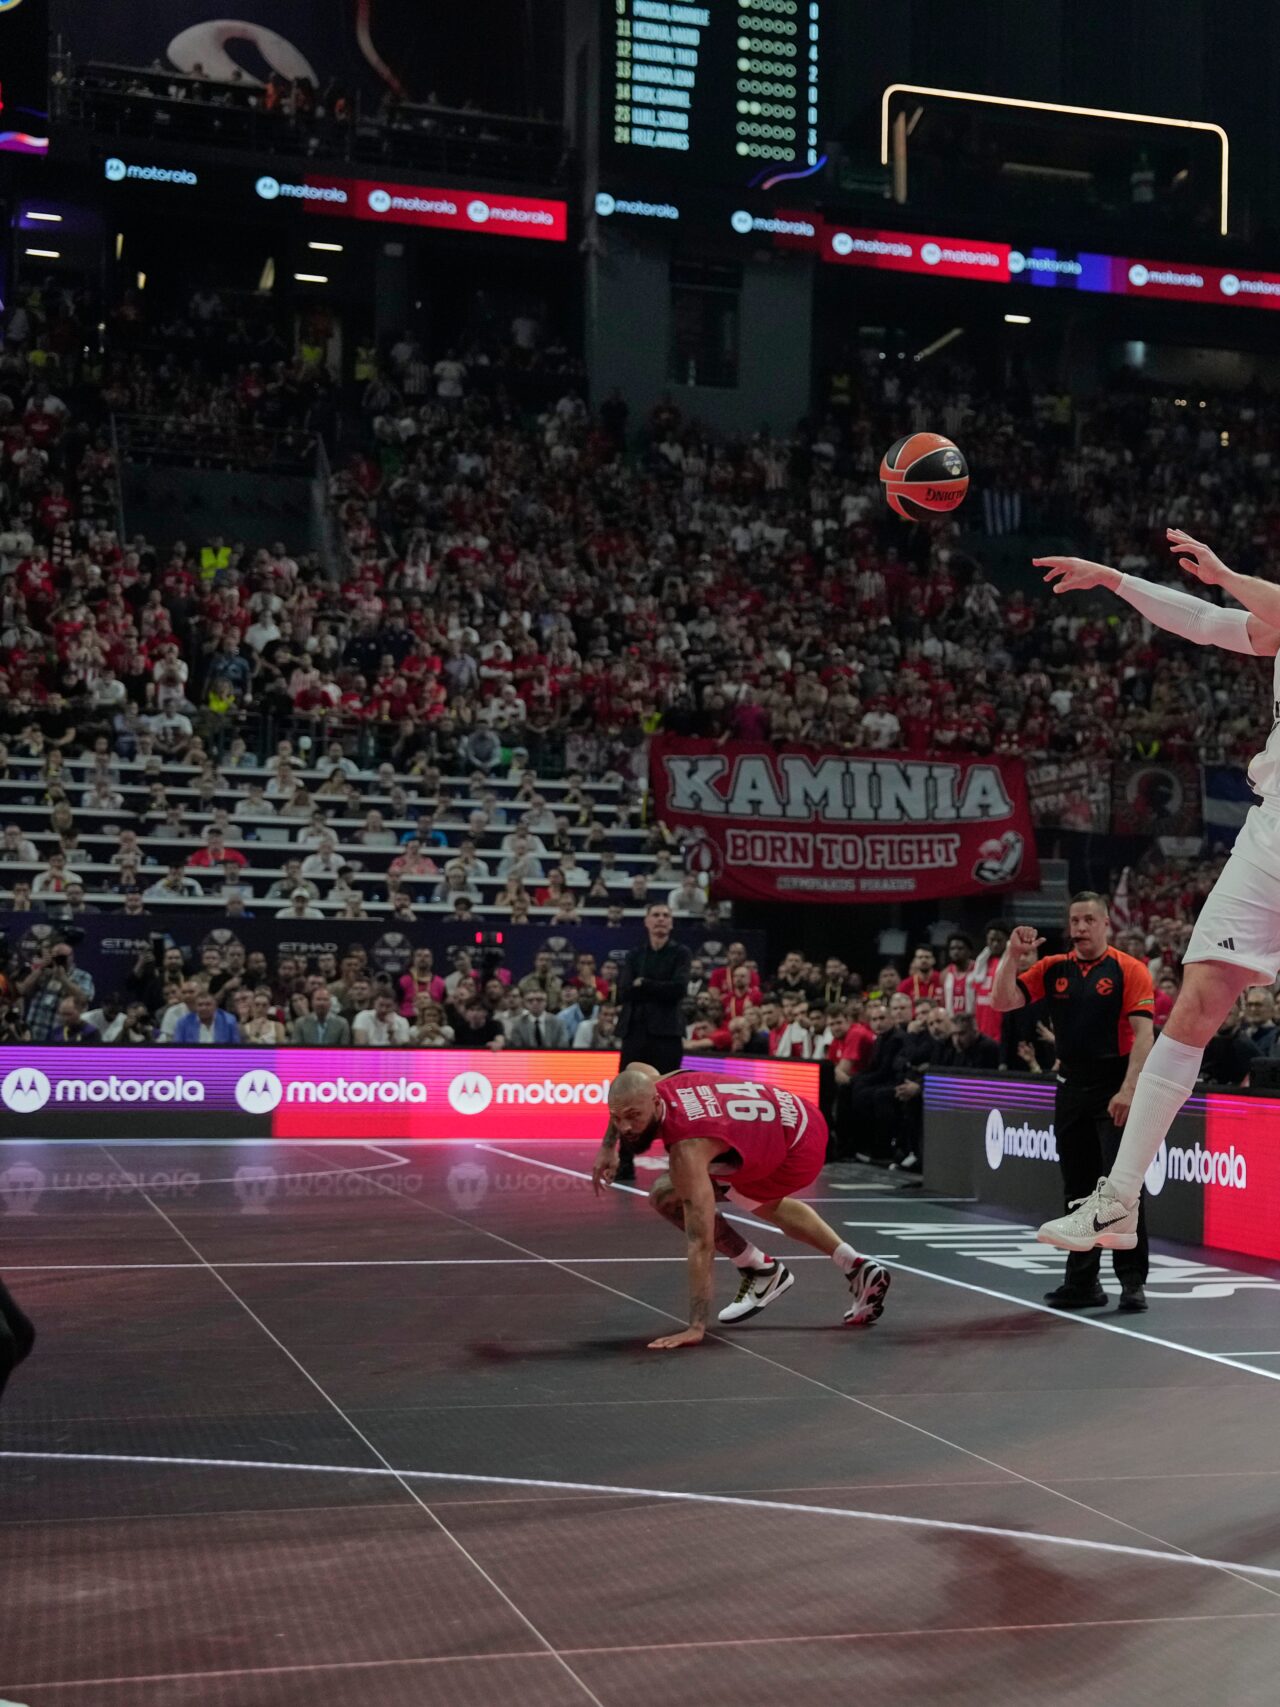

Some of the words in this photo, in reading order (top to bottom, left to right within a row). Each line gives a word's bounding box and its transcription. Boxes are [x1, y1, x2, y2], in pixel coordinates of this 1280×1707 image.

[127, 165, 197, 185] motorola
[279, 183, 348, 203] motorola
[391, 196, 457, 215] motorola
[615, 199, 679, 219] motorola
[490, 207, 553, 225] motorola
[753, 217, 815, 237] motorola
[853, 238, 913, 257] motorola
[940, 248, 1000, 267] motorola
[1025, 257, 1083, 275] motorola
[1148, 269, 1204, 288] motorola
[663, 753, 1014, 824] KAMINIA
[726, 830, 815, 868] BORN
[819, 832, 861, 870] TO
[864, 832, 962, 871] FIGHT
[278, 942, 338, 953] ETIHAD
[55, 1075, 205, 1102] motorola
[287, 1077, 427, 1103] motorola
[496, 1079, 610, 1104] motorol
[715, 1082, 775, 1122] 94
[1168, 1142, 1247, 1189] motorola
